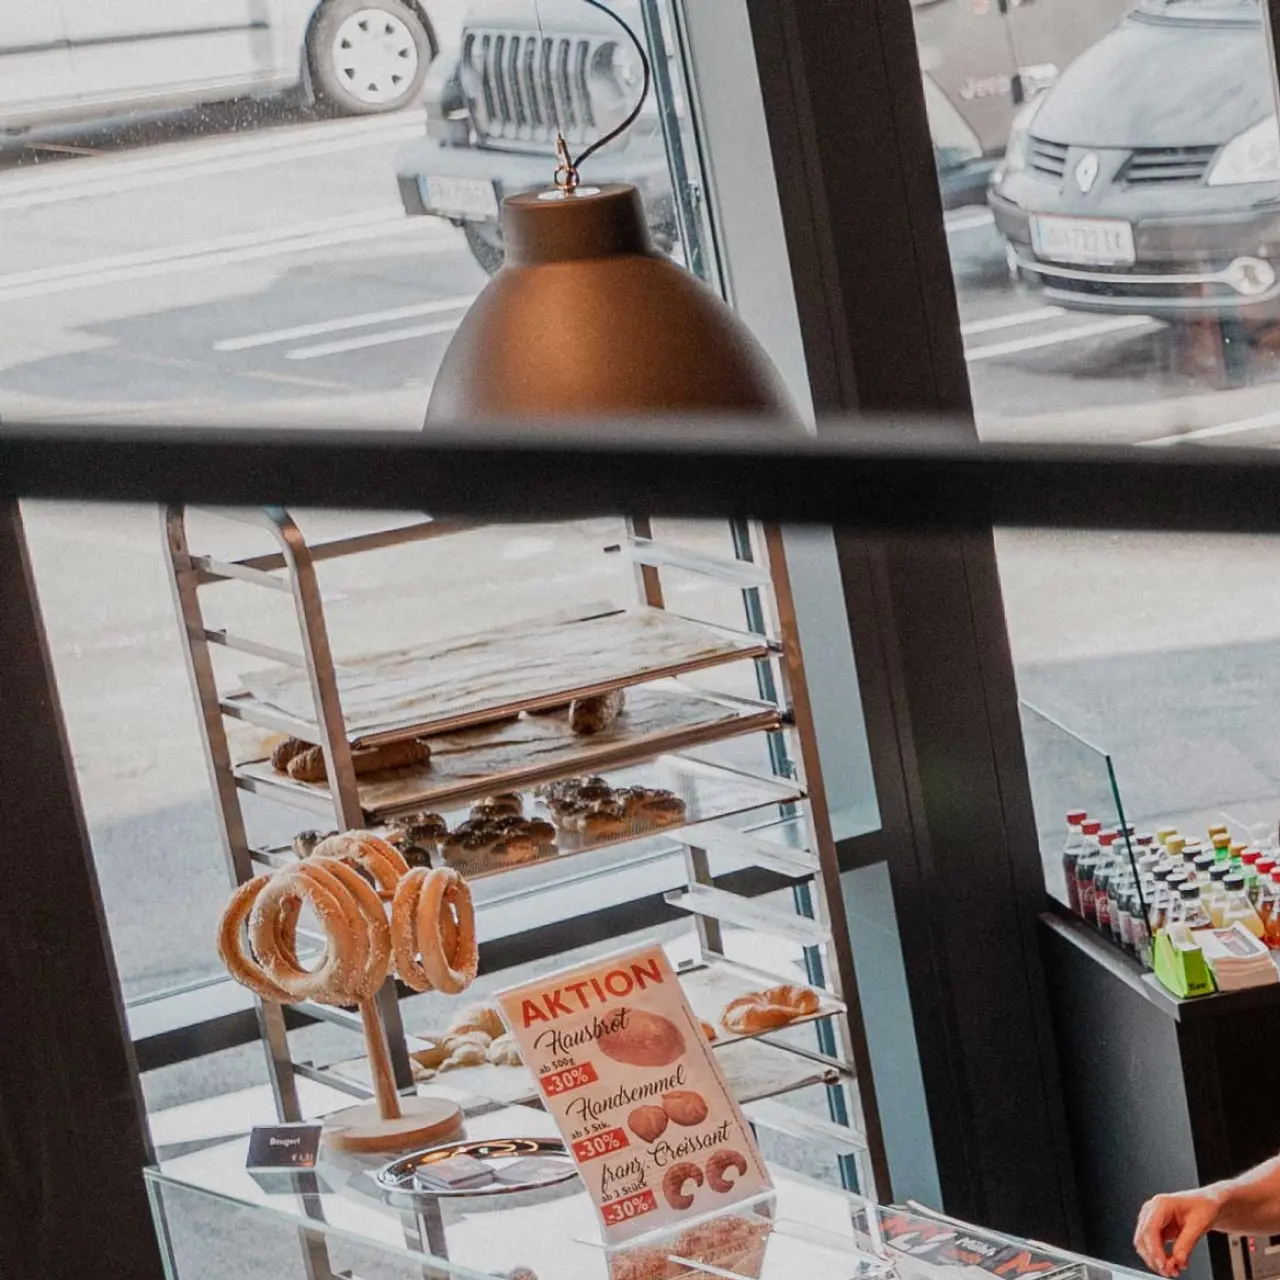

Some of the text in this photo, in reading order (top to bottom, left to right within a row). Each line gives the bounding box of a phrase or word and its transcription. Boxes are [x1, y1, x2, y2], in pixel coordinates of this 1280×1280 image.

[520, 957, 664, 1029] AKTION
[533, 1007, 631, 1056] Hausbrot
[539, 1058, 576, 1074] ab 500g
[547, 1067, 588, 1092] -30%
[565, 1065, 687, 1120] Handsemmel
[571, 1130, 583, 1140] ab
[579, 1132, 620, 1157] -30%
[601, 1119, 732, 1194] franz. Croissant
[601, 1193, 613, 1202] ab
[621, 1180, 649, 1196] Stück
[607, 1196, 650, 1222] -30%
